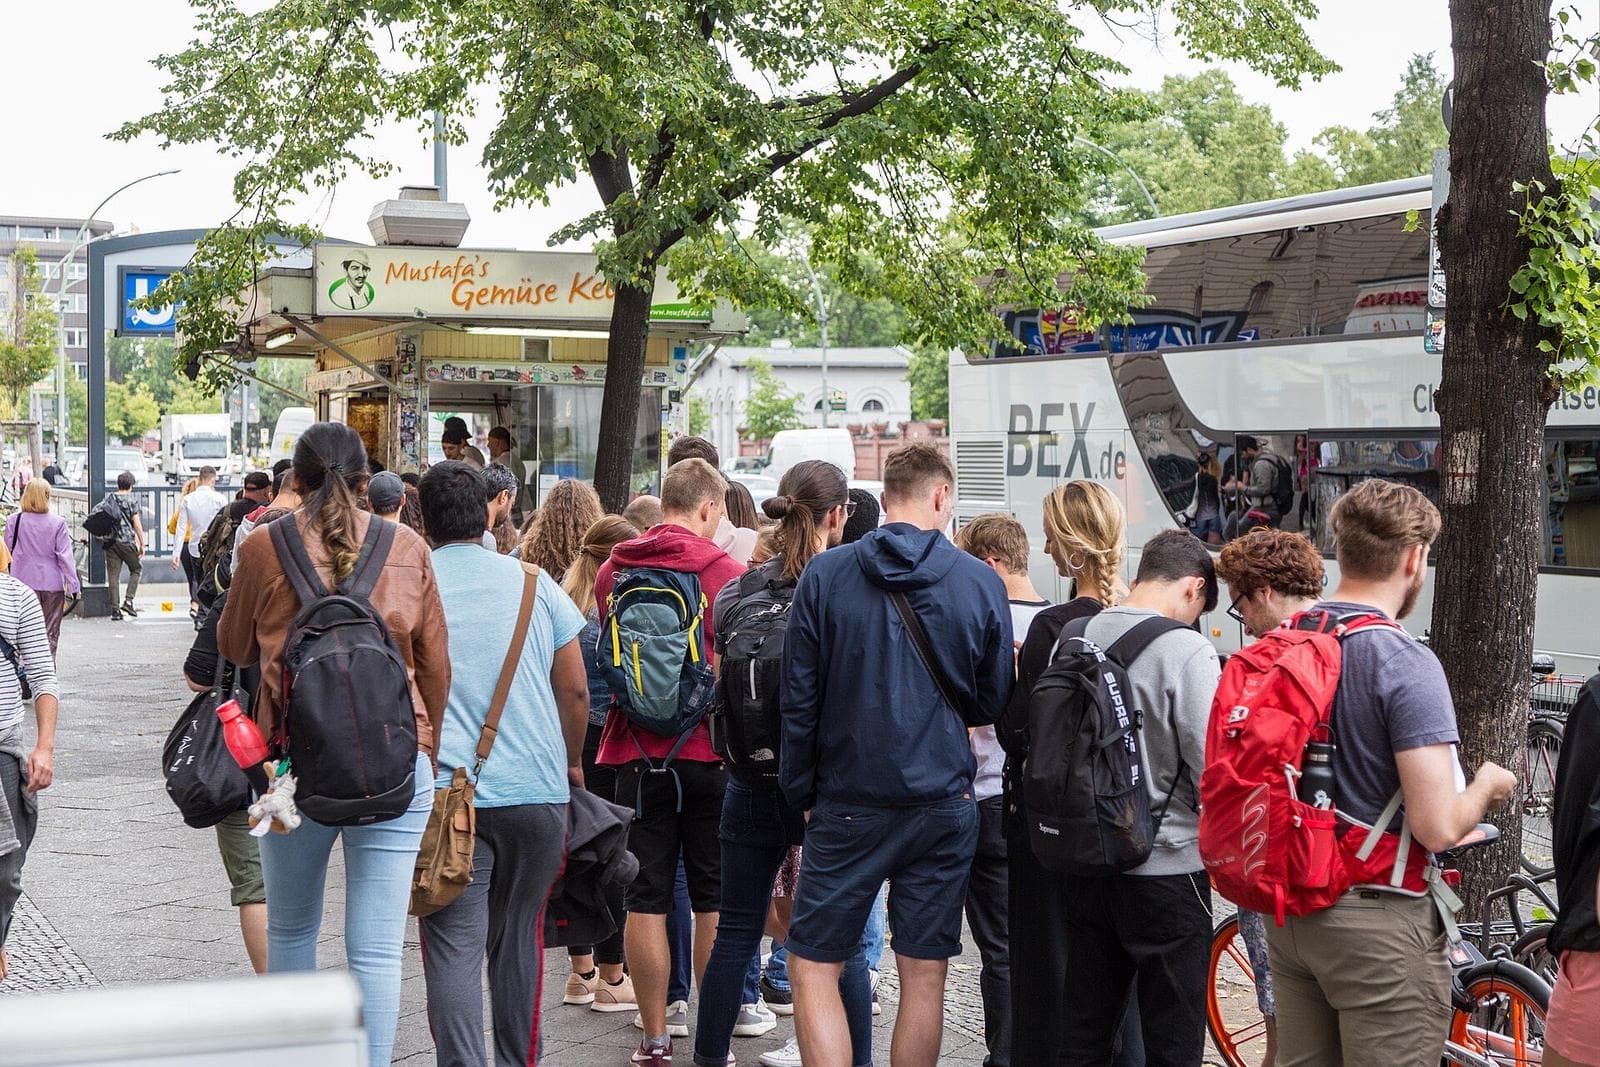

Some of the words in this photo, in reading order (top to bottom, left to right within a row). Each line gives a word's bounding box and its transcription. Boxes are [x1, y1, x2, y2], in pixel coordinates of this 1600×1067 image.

[385, 255, 490, 284] Mustafa's
[451, 278, 559, 311] Gemüse
[1006, 401, 1127, 480] BEX.de
